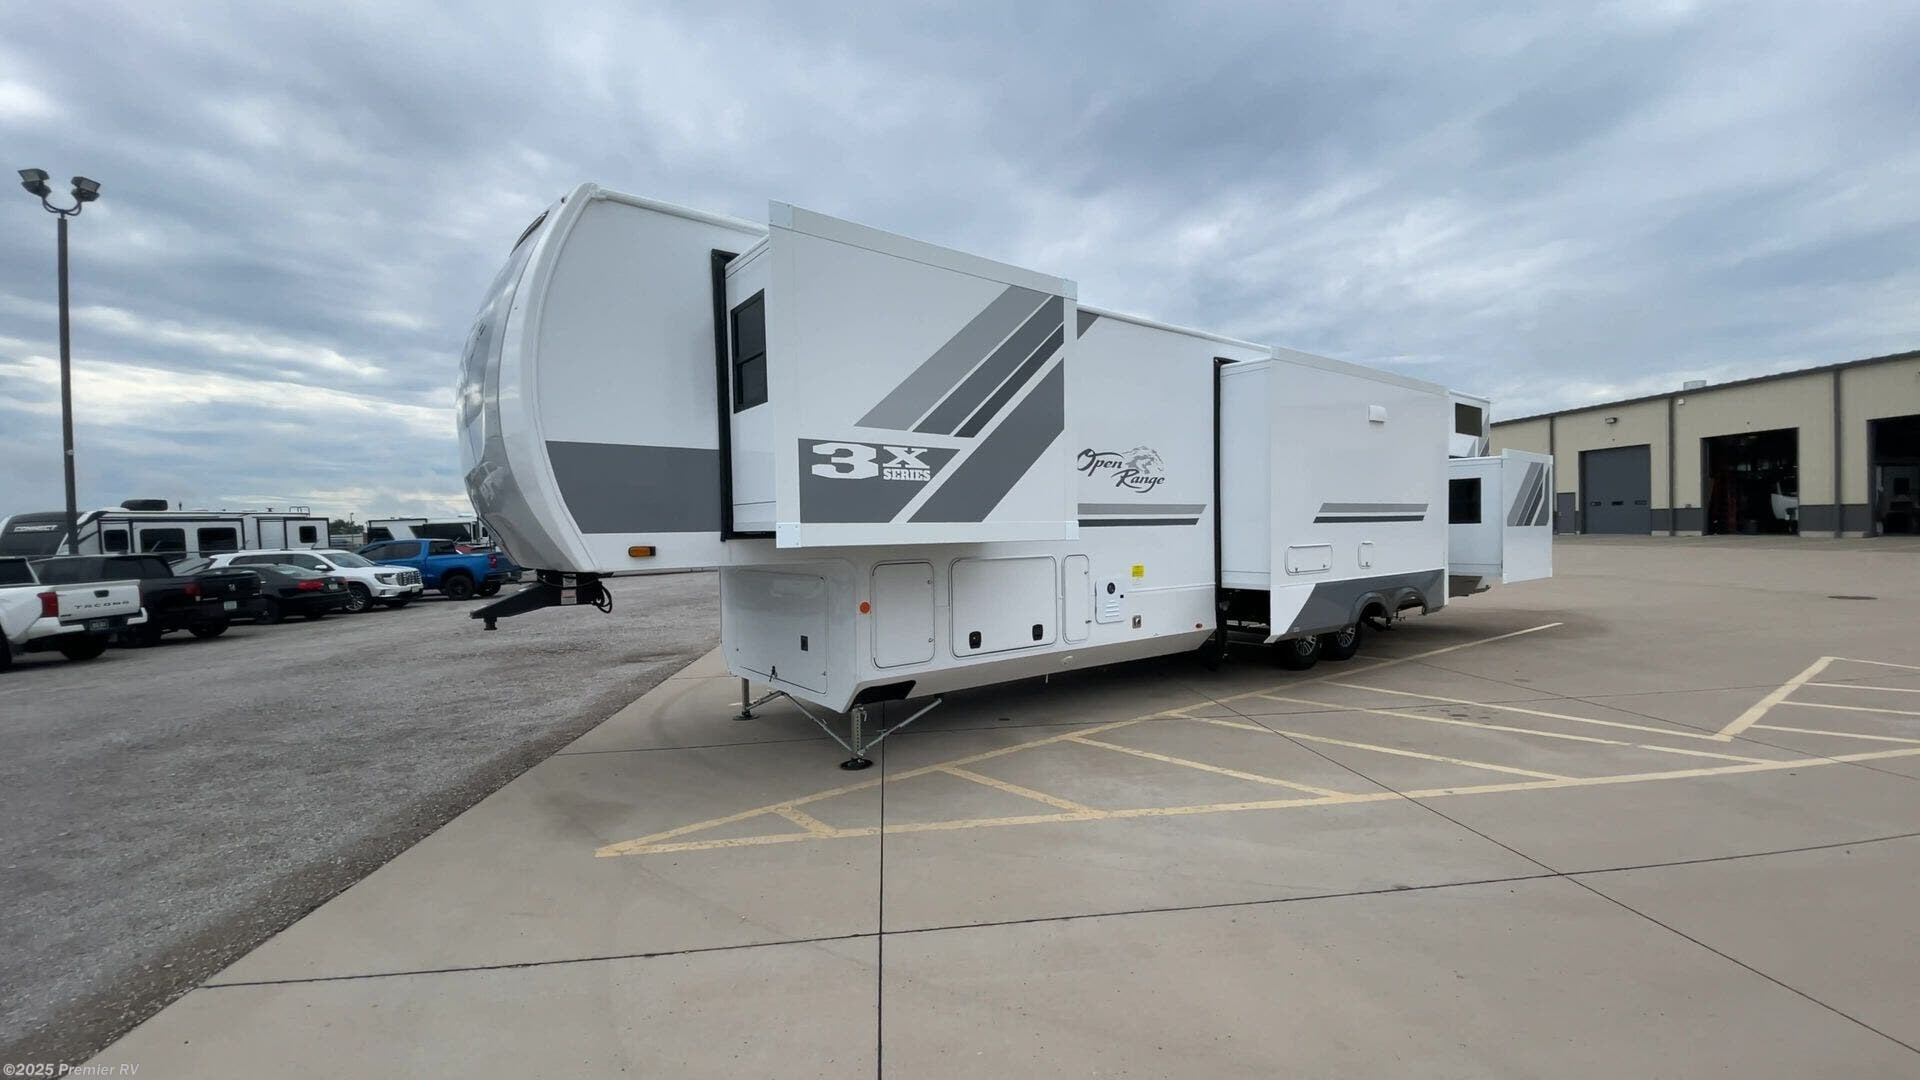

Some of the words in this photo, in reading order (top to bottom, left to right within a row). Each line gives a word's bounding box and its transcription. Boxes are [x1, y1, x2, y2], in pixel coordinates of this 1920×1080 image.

[1077, 448, 1124, 477] Open
[883, 468, 931, 482] SERIES
[1111, 469, 1165, 493] Range
[74, 600, 130, 609] TACOMA
